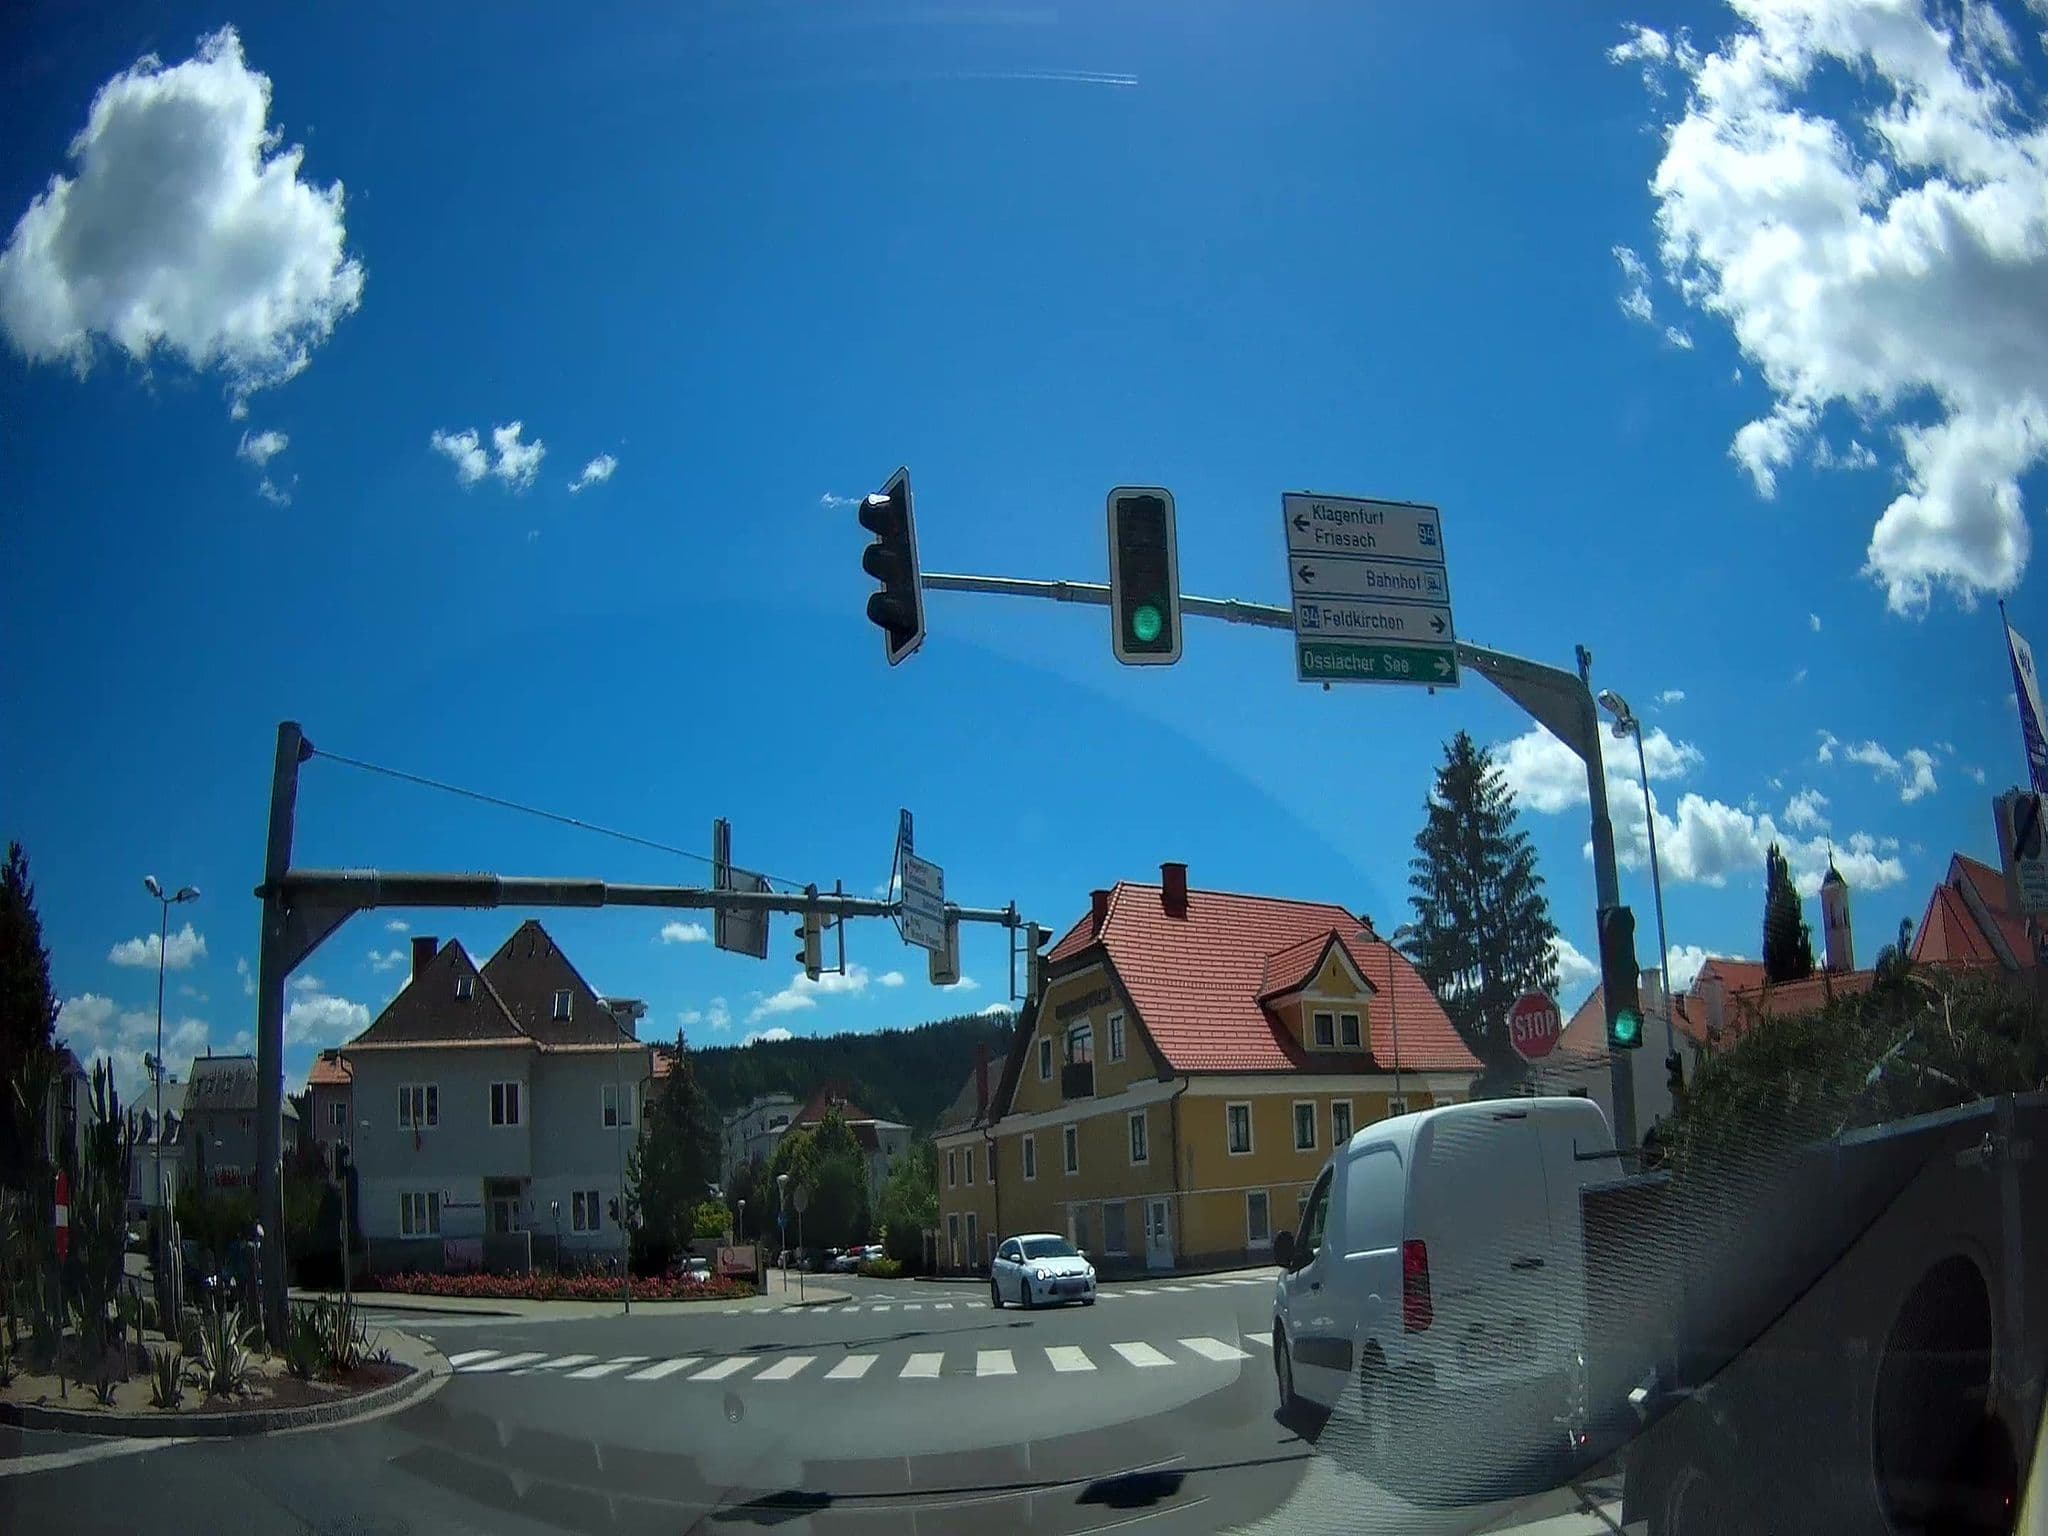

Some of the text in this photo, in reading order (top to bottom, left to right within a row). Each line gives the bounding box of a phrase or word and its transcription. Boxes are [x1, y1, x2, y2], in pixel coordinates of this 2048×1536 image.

[1312, 504, 1384, 526] Klagenfurt
[1314, 528, 1376, 548] Friesach
[1366, 570, 1421, 590] Bahnhof
[1323, 608, 1404, 630] Feldkirchen
[1304, 651, 1410, 673] Ossiacher See
[1515, 1010, 1555, 1041] STOP
